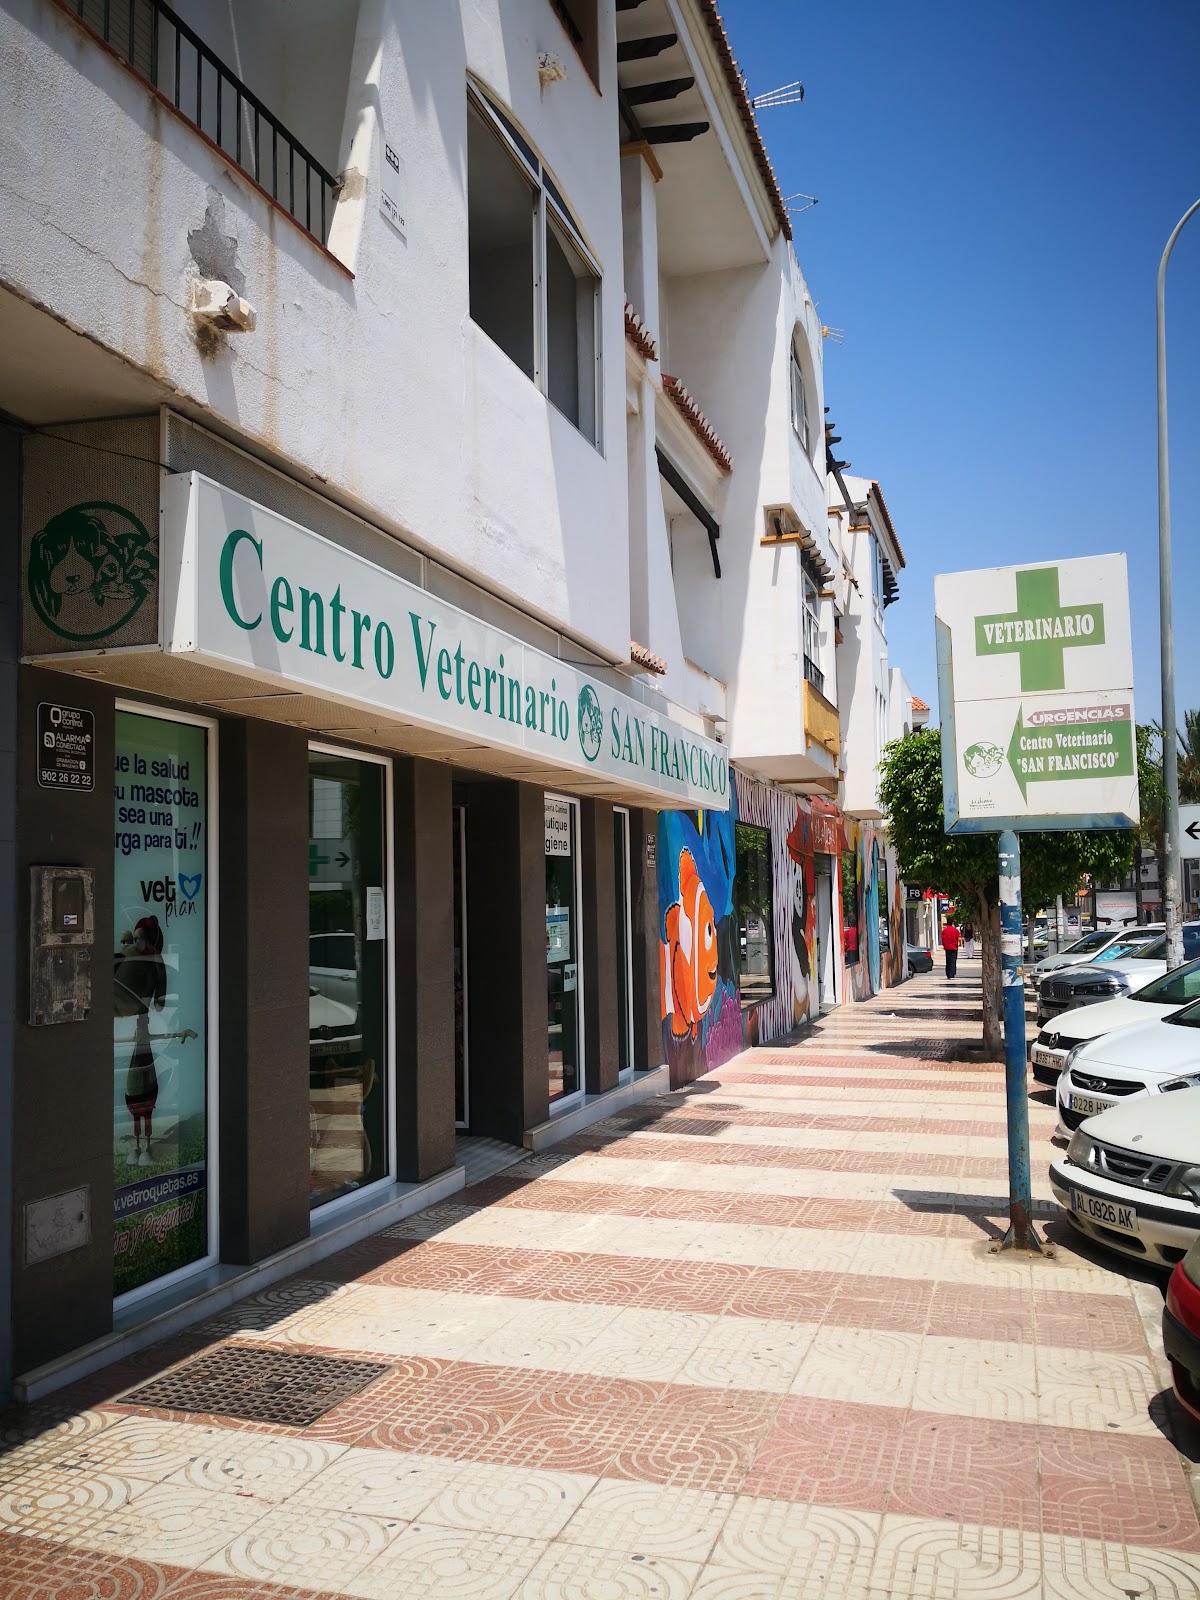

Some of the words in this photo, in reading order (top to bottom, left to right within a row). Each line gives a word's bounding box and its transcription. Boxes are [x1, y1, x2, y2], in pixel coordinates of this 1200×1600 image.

[983, 613, 1095, 645] VETERINARIO
[219, 528, 395, 680] Centro
[408, 611, 569, 743] Veterinario
[611, 706, 645, 767] SAN
[650, 725, 727, 796] FRANCISCO
[62, 710, 81, 719] grupo
[62, 719, 83, 728] control
[1032, 707, 1125, 724] URGENCIAS
[56, 732, 86, 745] ALARMA
[56, 741, 87, 752] CONECTADA
[1020, 735, 1053, 751] Centro
[1055, 729, 1114, 749] Veterinario
[134, 753, 147, 775] la
[151, 758, 189, 781] salud
[1017, 755, 1044, 774] "SAN
[1048, 751, 1119, 772] FRANCISCO"
[42, 771, 57, 782] 902
[58, 772, 69, 783] 26
[70, 773, 80, 785] 22
[81, 775, 92, 786] 22
[130, 784, 199, 808] mascota
[118, 806, 146, 824] sea
[150, 811, 173, 827] una
[544, 816, 568, 834] utique
[114, 832, 141, 856] rga
[144, 833, 172, 851] para
[140, 875, 176, 903] vet
[165, 899, 197, 927] plan
[1073, 1096, 1094, 1113] 0228
[1077, 1193, 1088, 1213] AL
[1089, 1198, 1116, 1223] 0926
[1118, 1207, 1133, 1229] AK
